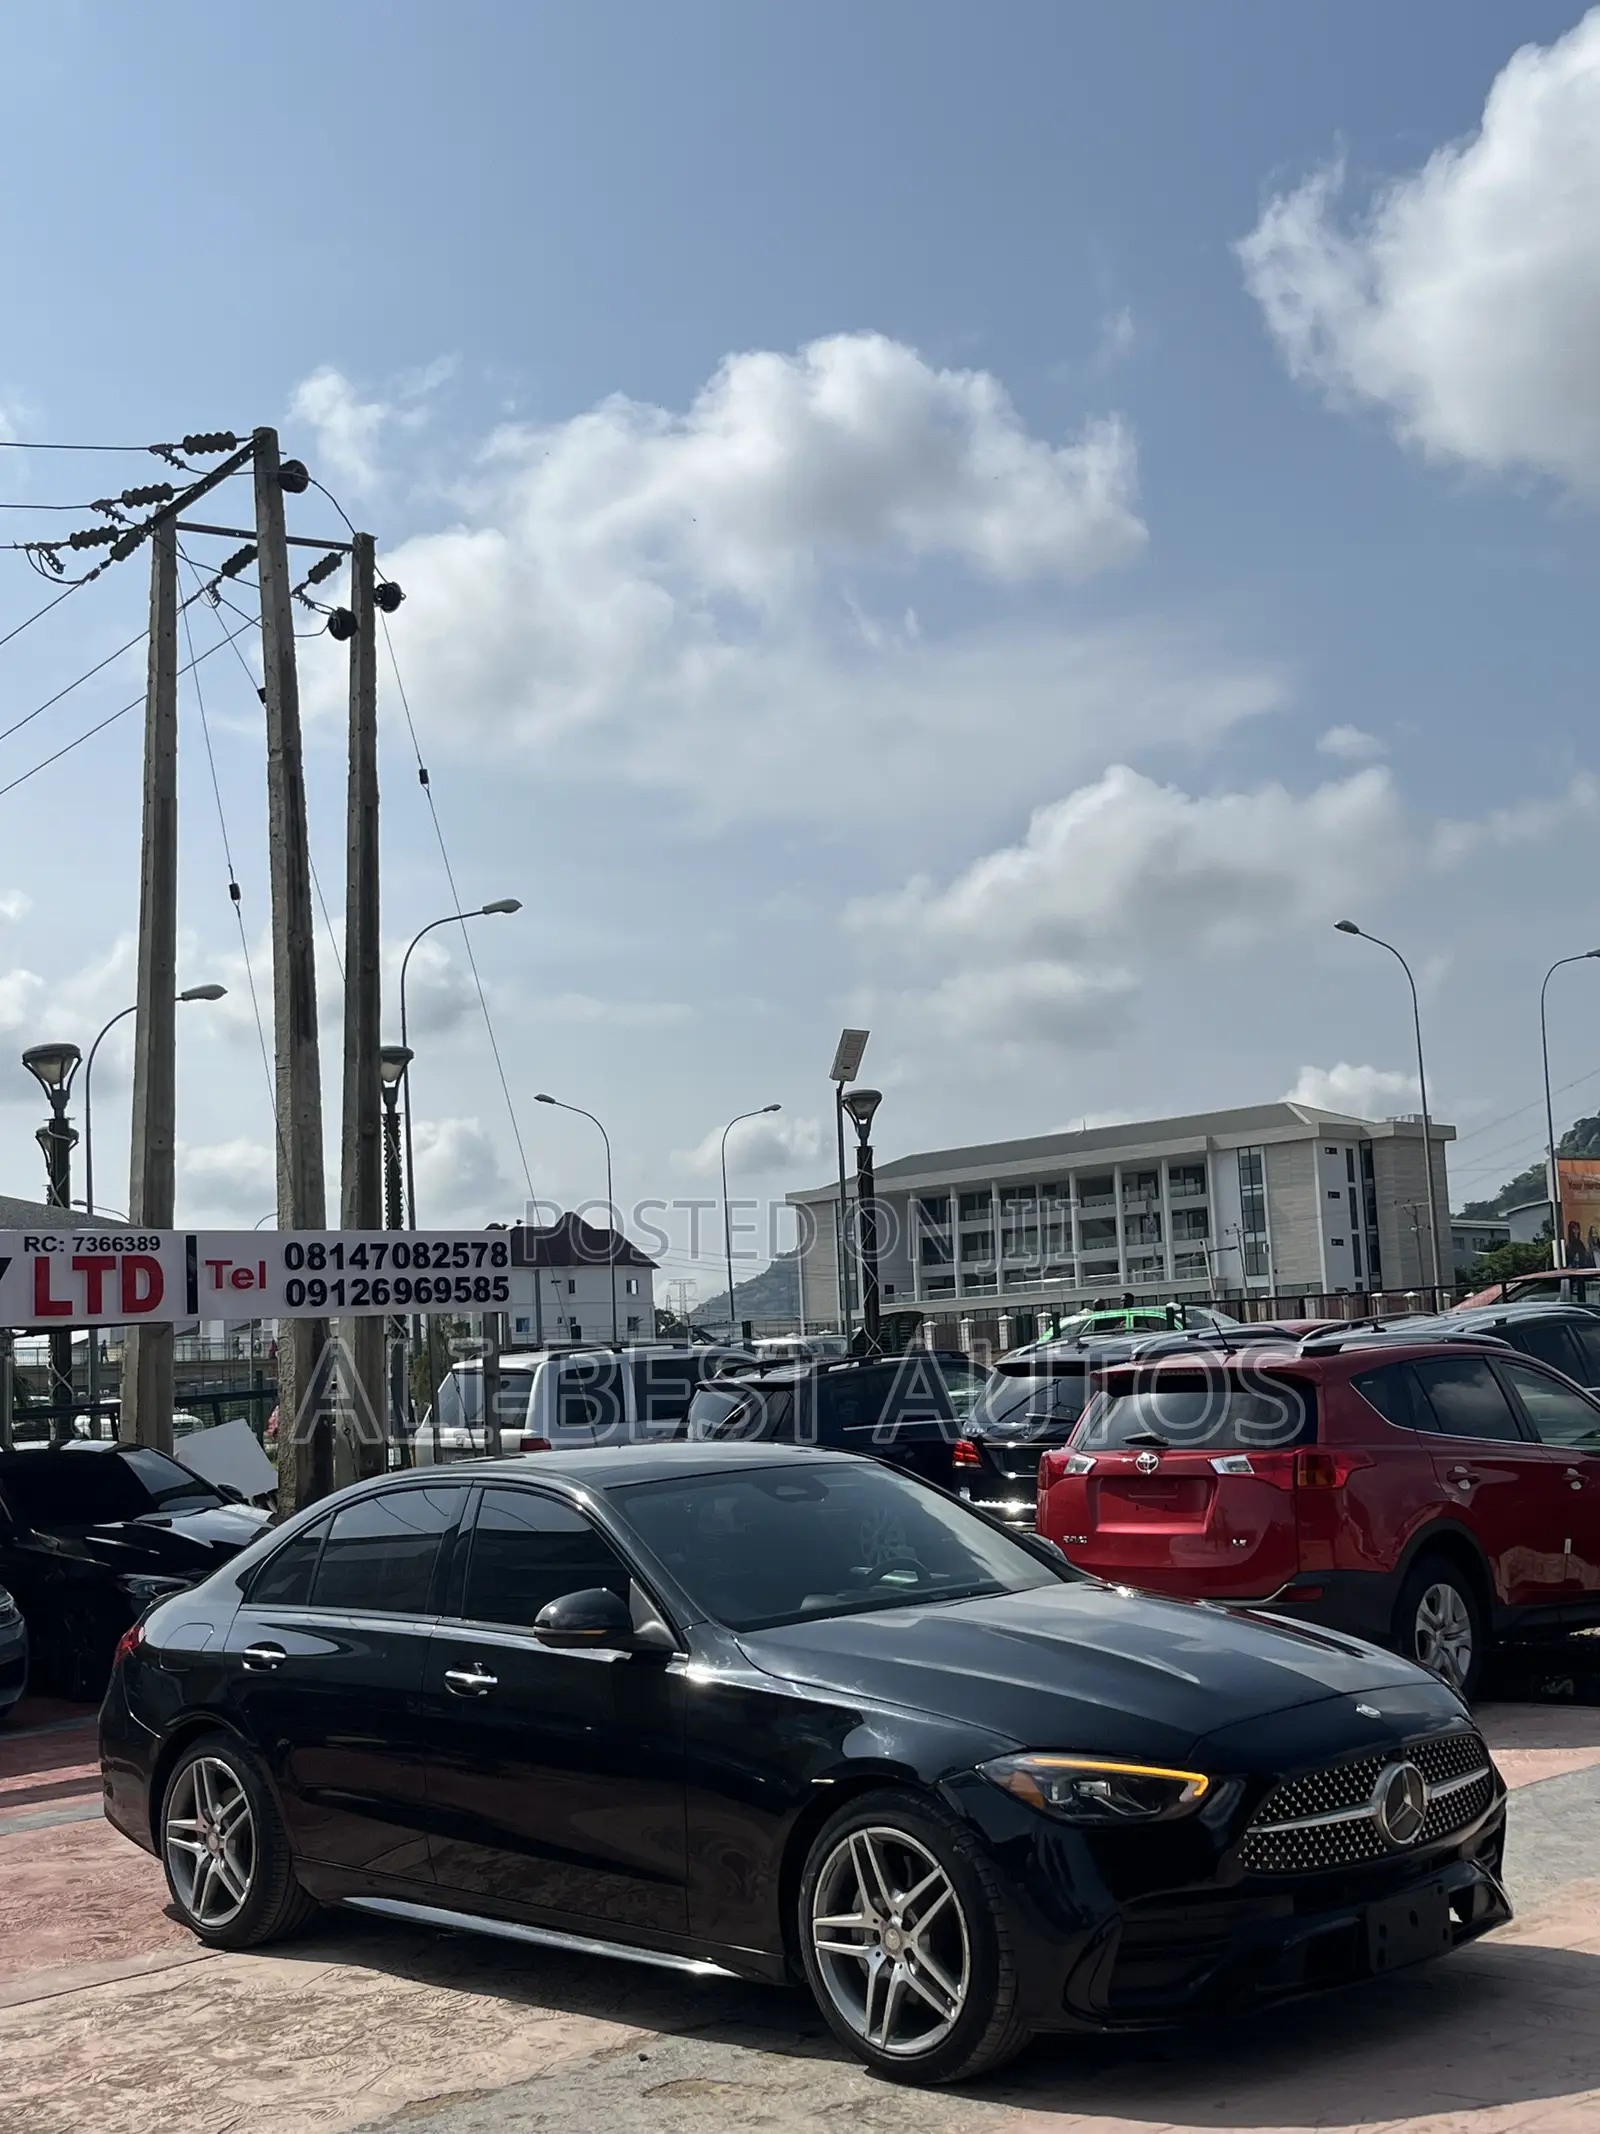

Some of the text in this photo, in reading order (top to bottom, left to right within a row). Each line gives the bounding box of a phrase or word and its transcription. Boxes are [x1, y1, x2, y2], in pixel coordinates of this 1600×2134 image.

[24, 1235, 161, 1252] RC: 7366389
[284, 1241, 508, 1270] 08147082578
[34, 1255, 165, 1316] LTD
[205, 1260, 267, 1289] Tel
[285, 1275, 509, 1307] 09126969585
